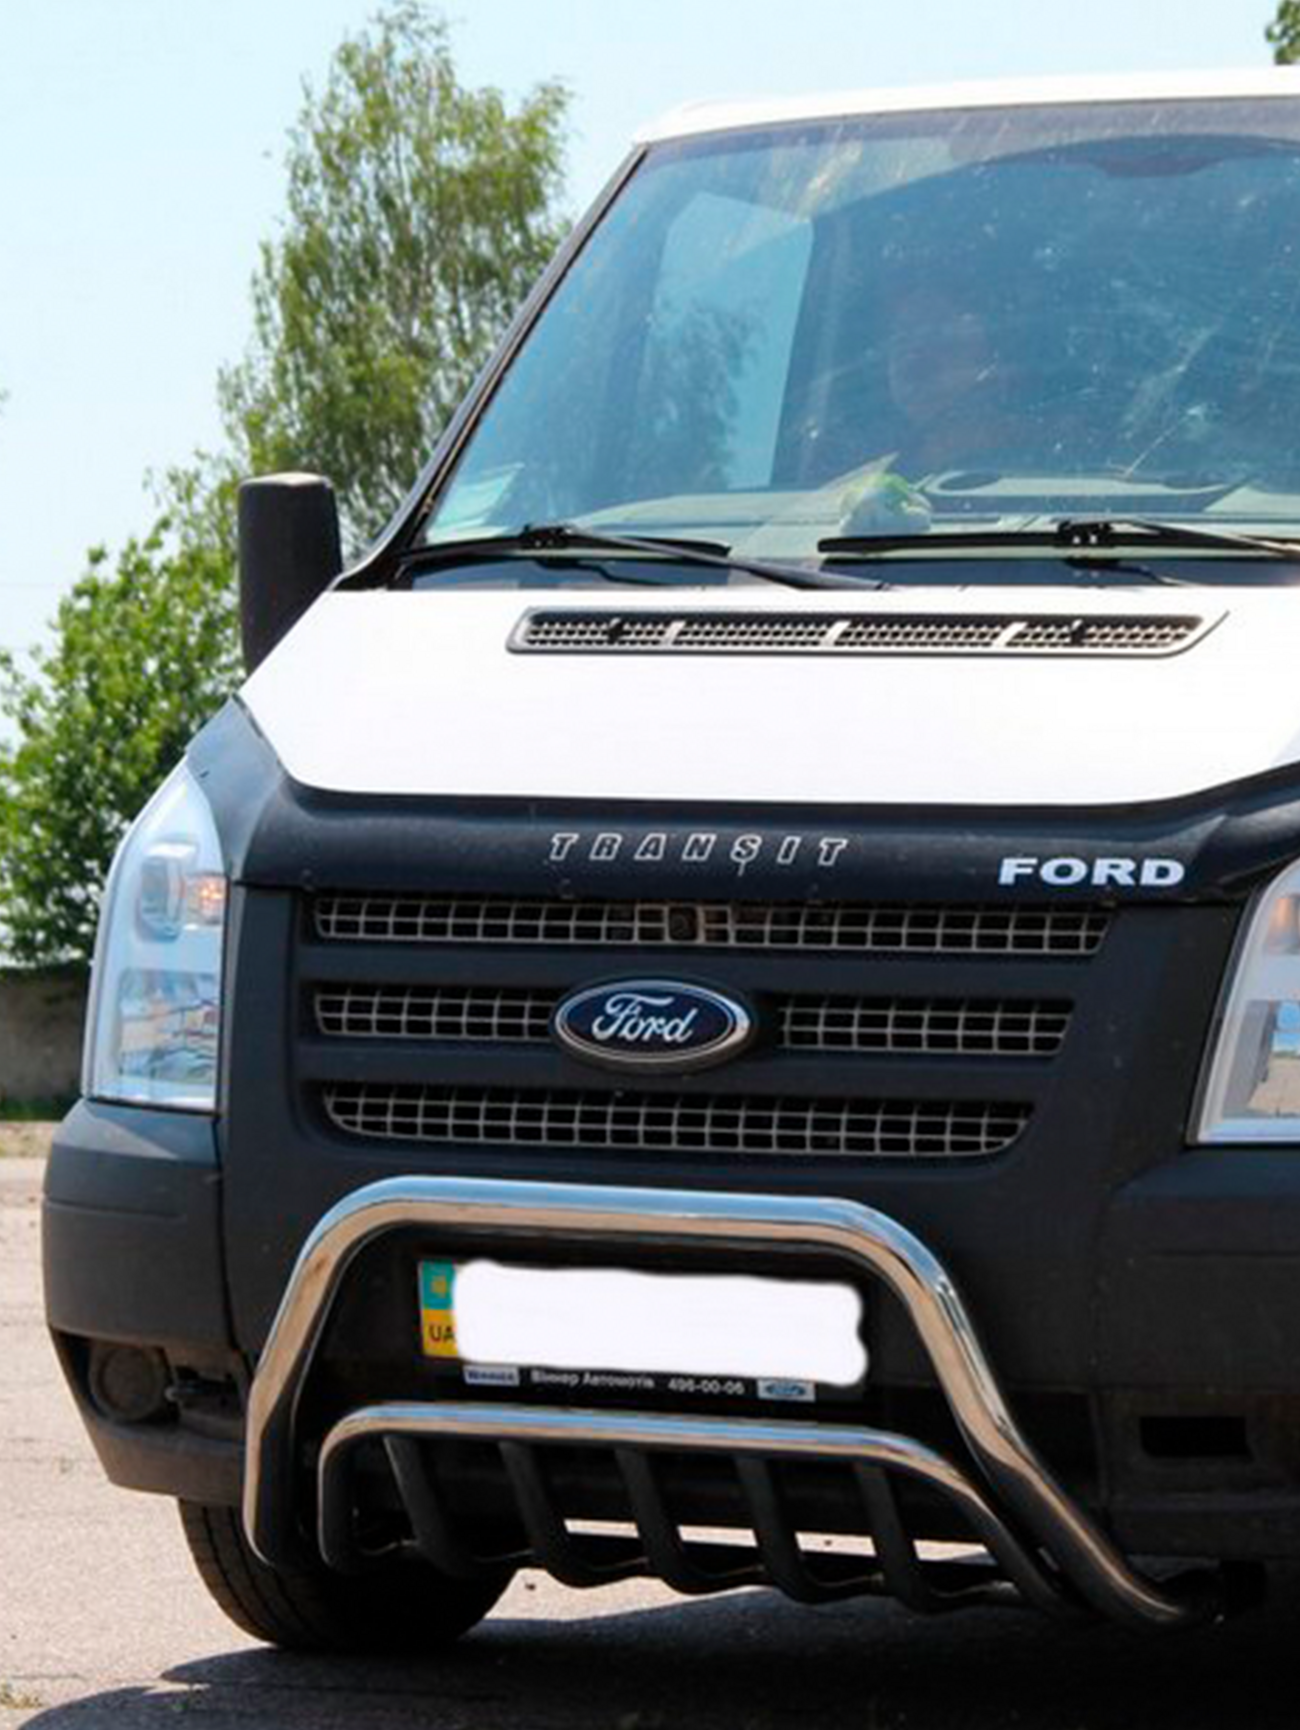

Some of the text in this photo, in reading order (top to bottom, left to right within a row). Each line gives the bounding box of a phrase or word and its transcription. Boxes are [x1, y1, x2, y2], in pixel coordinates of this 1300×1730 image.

[548, 832, 848, 877] TRANSIT
[998, 857, 1186, 887] FORD
[591, 994, 695, 1044] Ford
